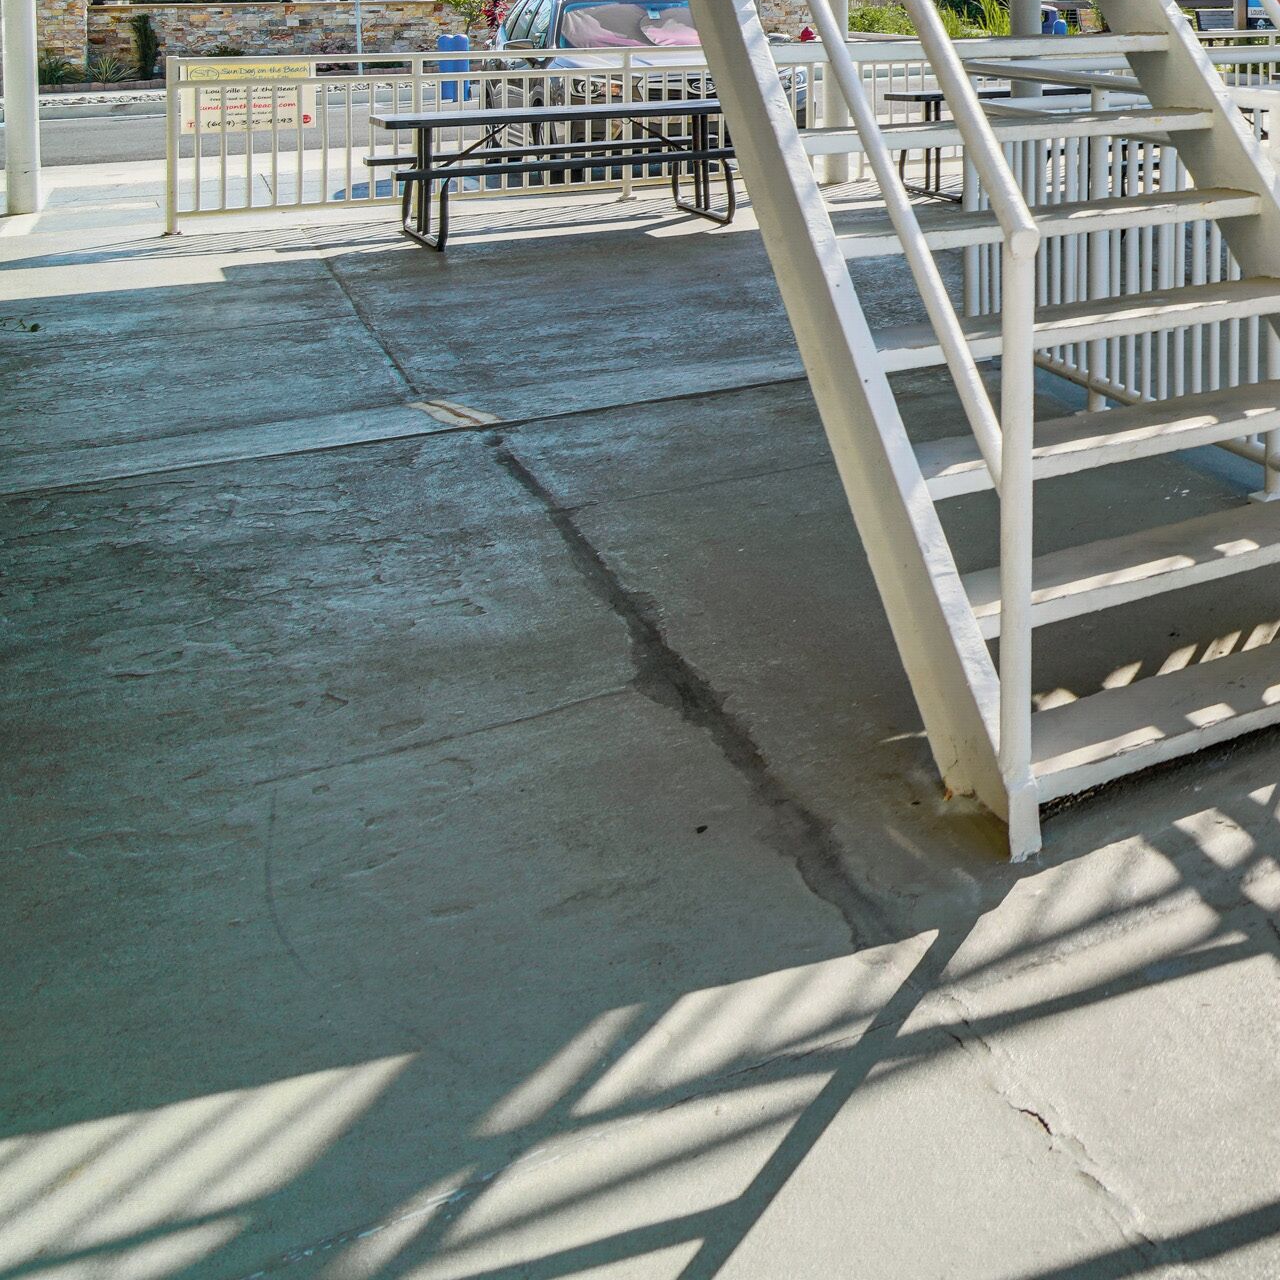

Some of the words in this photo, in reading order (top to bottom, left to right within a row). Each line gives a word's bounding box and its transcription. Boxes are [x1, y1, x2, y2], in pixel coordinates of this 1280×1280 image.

[239, 67, 256, 76] Dog
[282, 65, 307, 74] Beach
[205, 87, 241, 95] Louville
